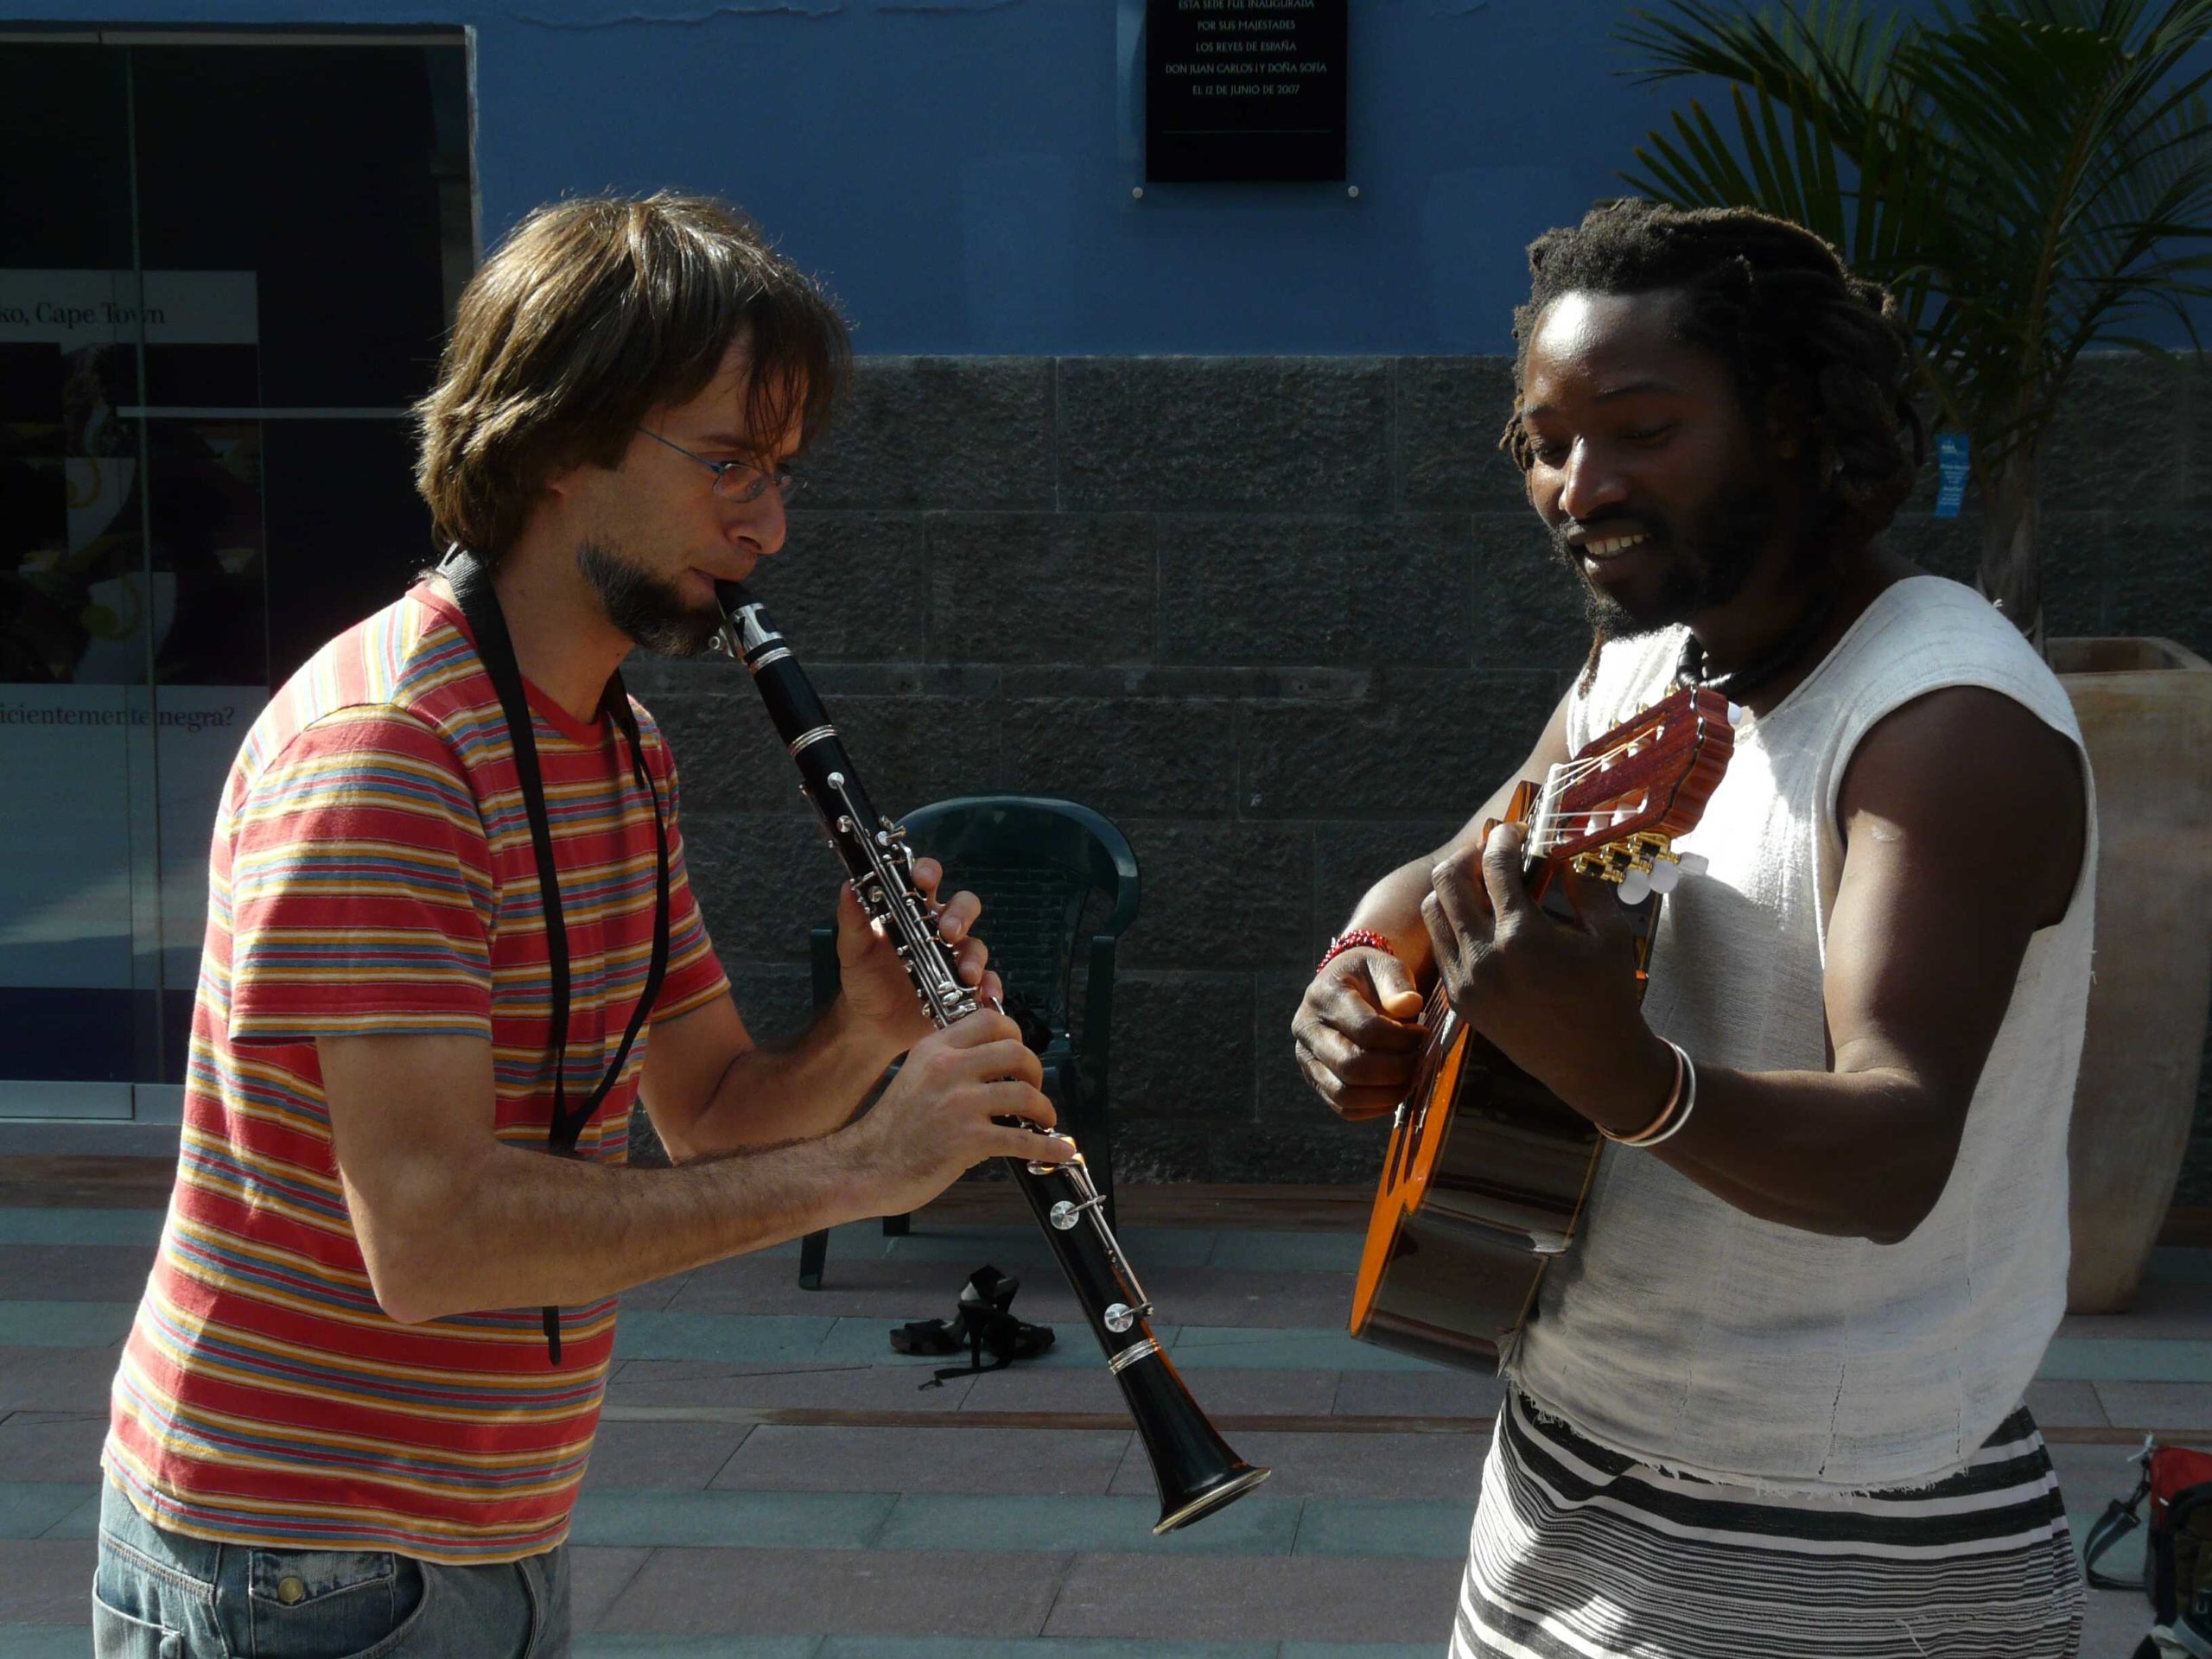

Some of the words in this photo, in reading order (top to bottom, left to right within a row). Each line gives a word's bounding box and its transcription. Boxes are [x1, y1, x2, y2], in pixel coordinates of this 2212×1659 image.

[1179, 0, 1200, 10] ESTA
[1203, 0, 1224, 10] SEDE
[1227, 0, 1245, 10] FUE
[1248, 0, 1314, 10] INAUGURADA
[1198, 20, 1216, 31] POR
[1218, 20, 1236, 31] SUS
[1238, 20, 1295, 31] MAJESTADES
[1196, 41, 1213, 52] LOS
[1216, 41, 1243, 52] REYES
[1246, 41, 1258, 52] DE
[1261, 40, 1297, 52] ESPAÑA
[1165, 63, 1187, 74] DON
[1190, 63, 1214, 74] JUAN
[1217, 63, 1253, 74] CARLOS
[1268, 61, 1298, 74] DOÑA
[1300, 61, 1327, 74] SOFÍA
[1192, 85, 1203, 95] EL
[1205, 85, 1213, 95] 12
[1216, 85, 1227, 95] DE
[1230, 85, 1260, 97] JUNIO
[1262, 85, 1274, 95] DE
[1277, 85, 1300, 95] 2007
[35, 302, 95, 329] Cape
[158, 706, 235, 733] negra?
